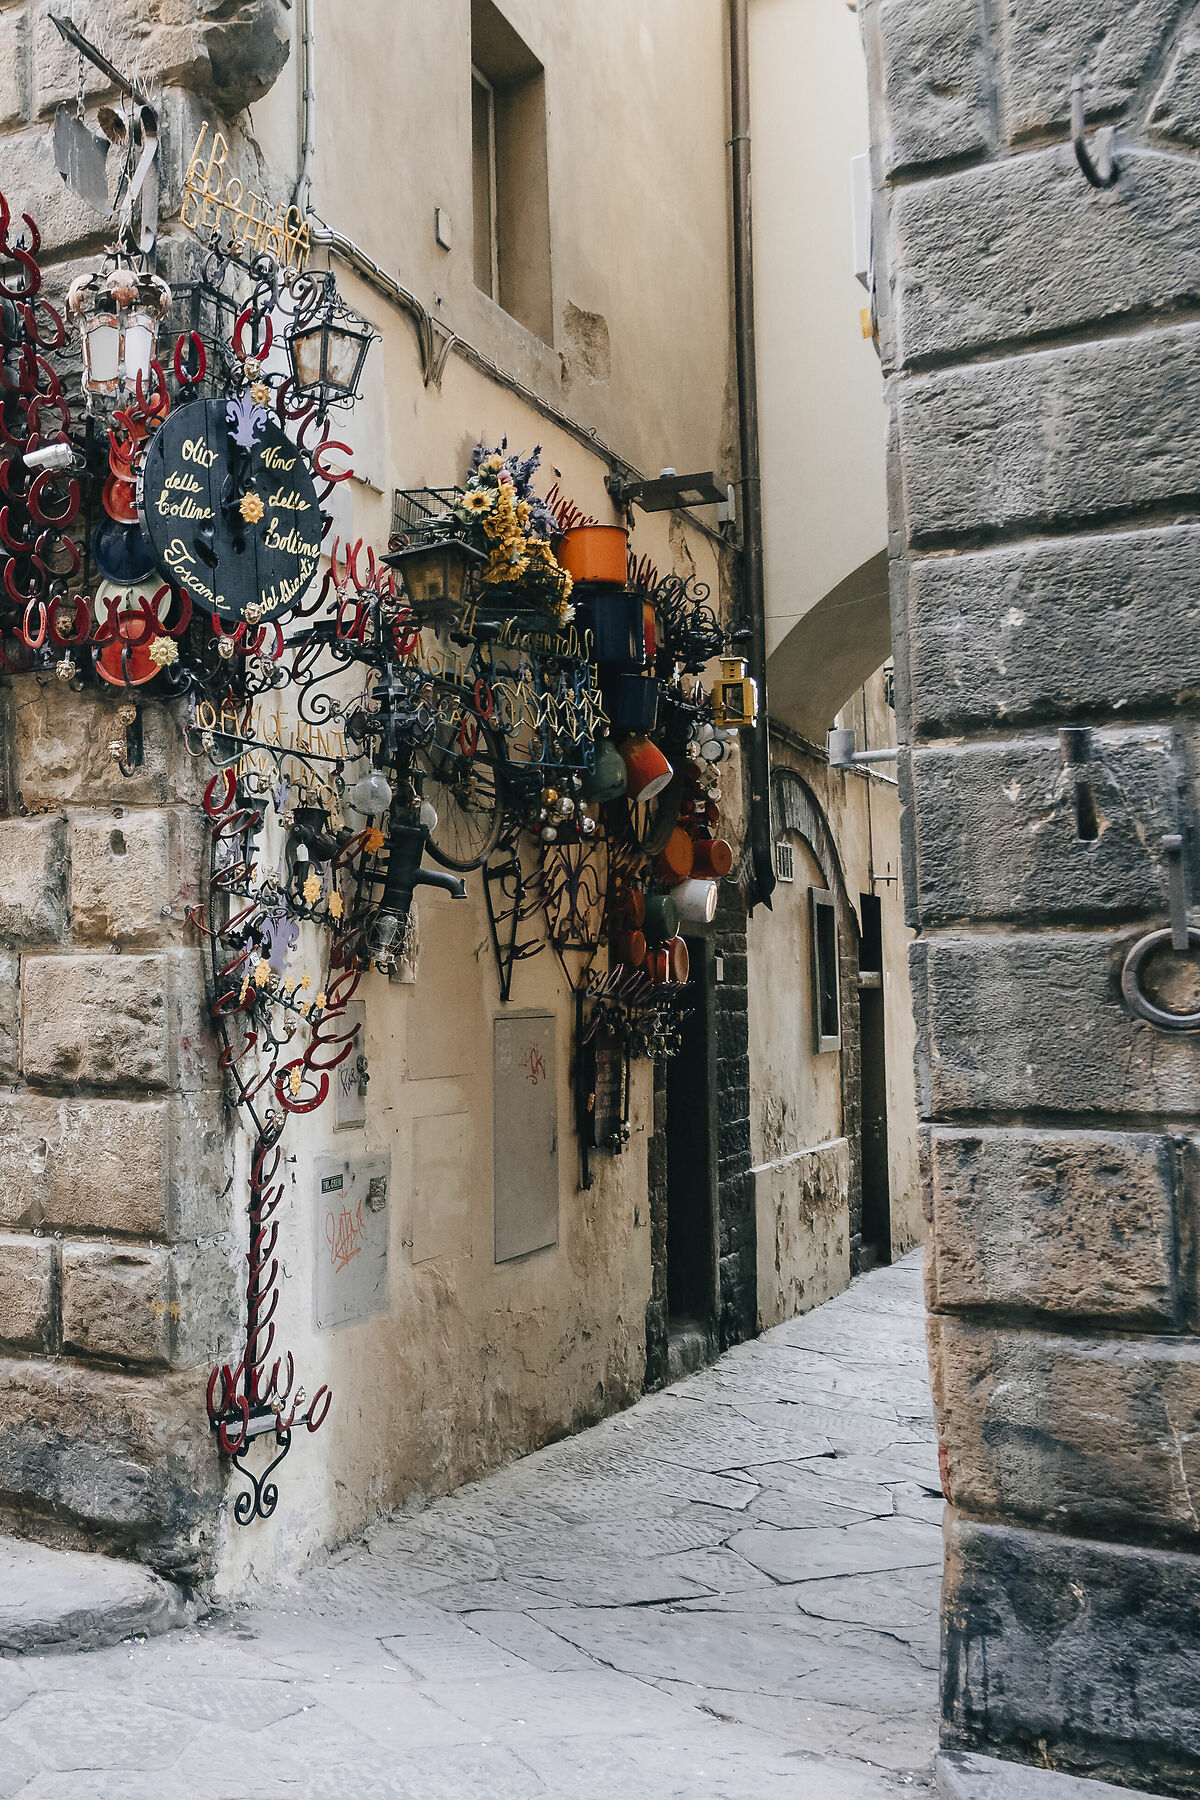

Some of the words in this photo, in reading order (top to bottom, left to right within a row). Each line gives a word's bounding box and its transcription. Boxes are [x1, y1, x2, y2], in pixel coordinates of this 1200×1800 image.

[181, 436, 219, 468] Olio
[260, 445, 297, 472] Vino
[164, 470, 204, 493] delle
[155, 490, 215, 520] Colline
[268, 486, 311, 511] delle
[264, 517, 321, 558] Colline
